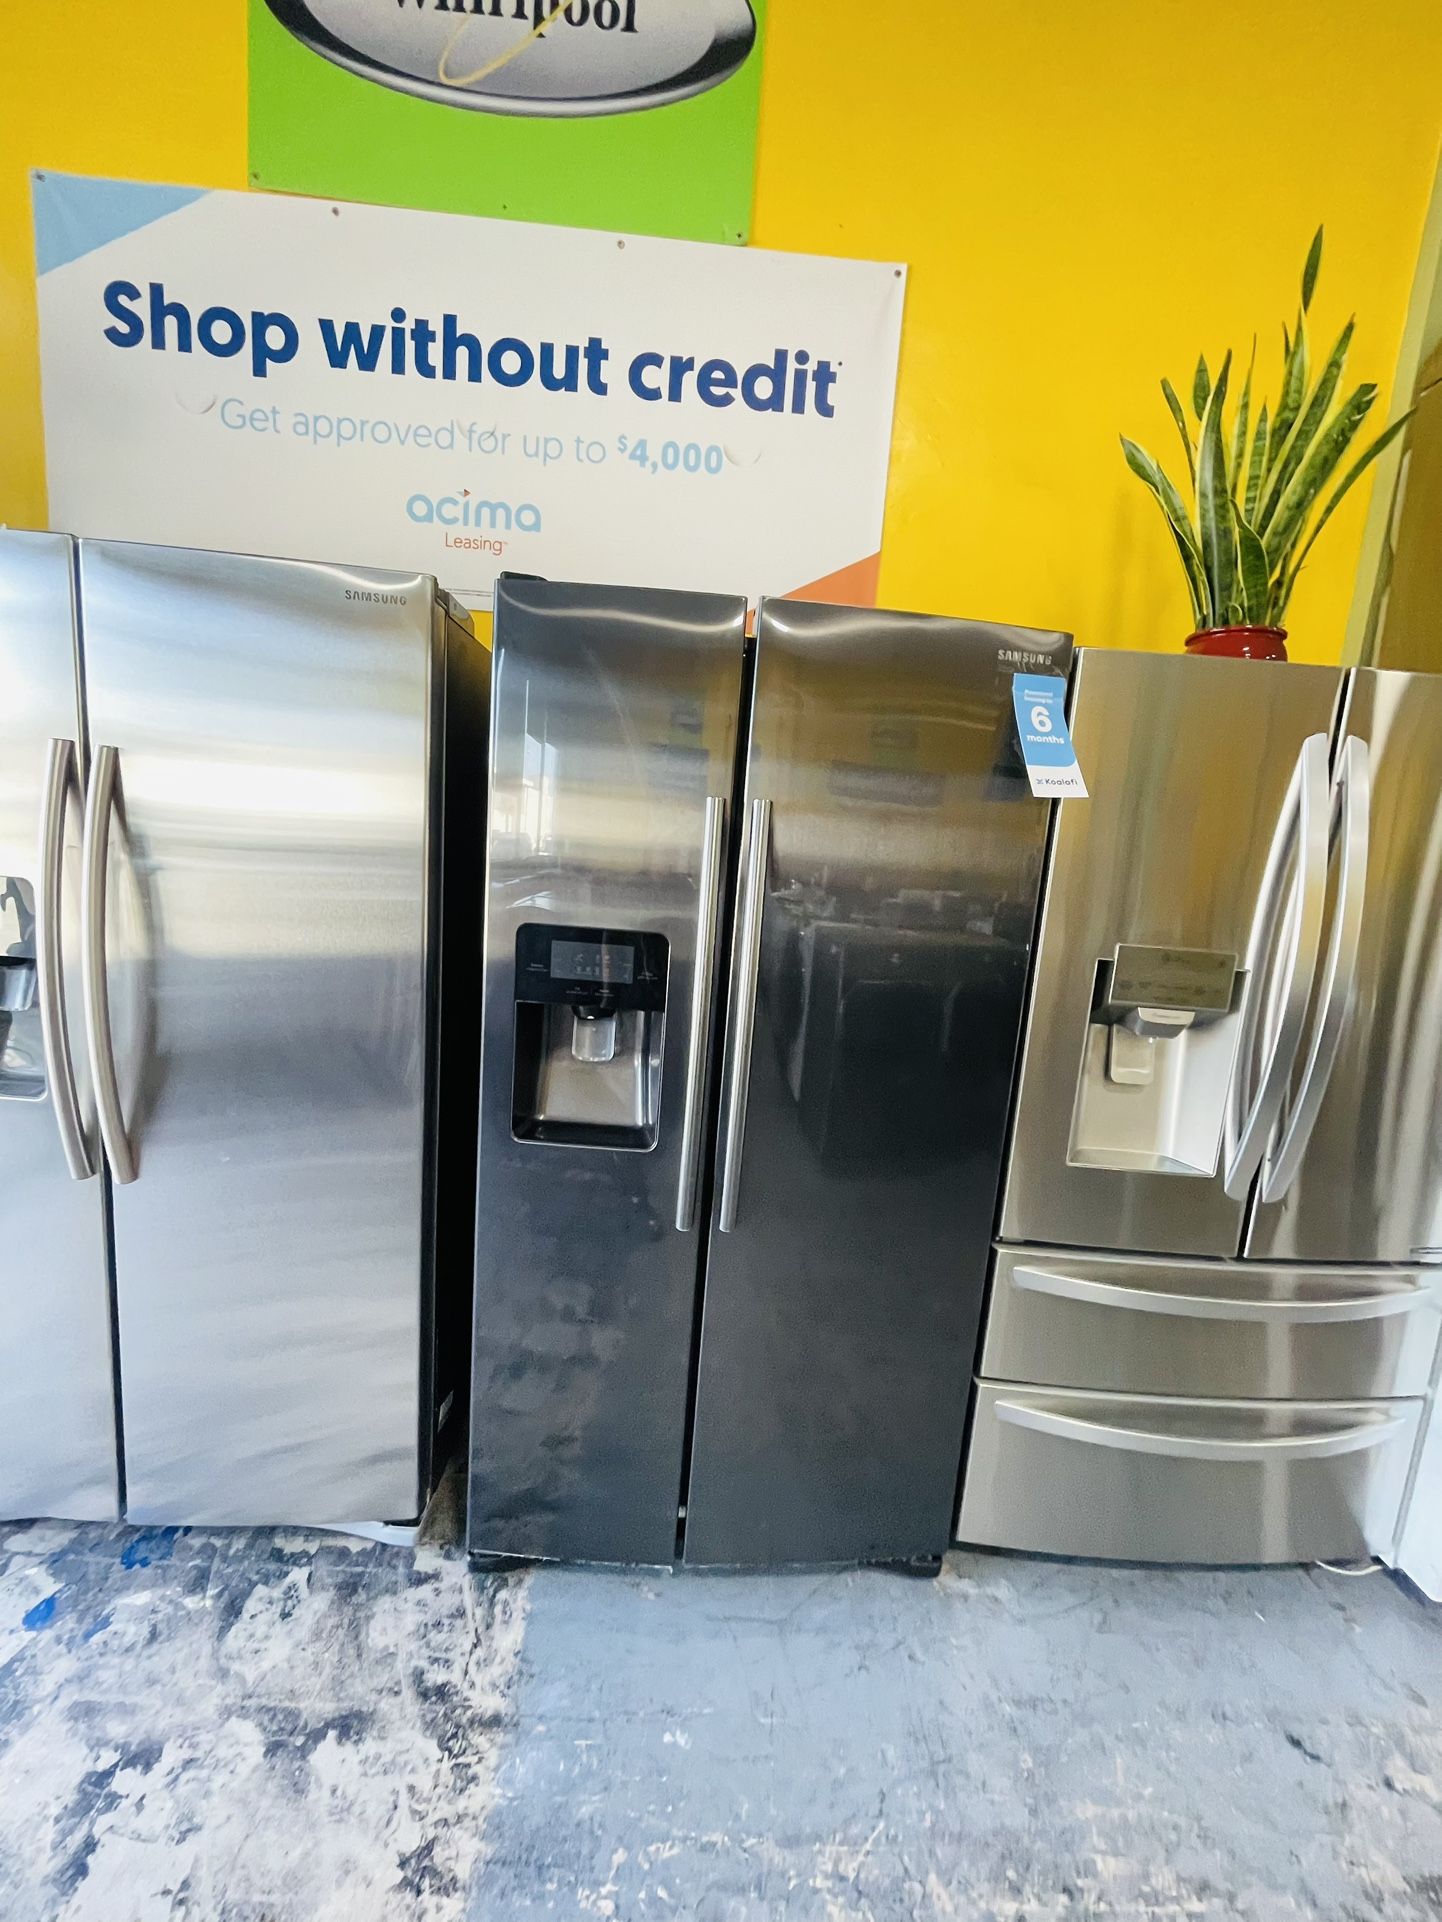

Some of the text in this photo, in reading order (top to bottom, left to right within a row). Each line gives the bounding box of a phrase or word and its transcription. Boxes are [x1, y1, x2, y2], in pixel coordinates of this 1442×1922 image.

[103, 280, 299, 378] Shop
[317, 307, 609, 396] without
[220, 397, 724, 475] Get approved for up to $4,000
[406, 493, 542, 533] acima
[445, 532, 503, 556] Leasing
[345, 589, 407, 605] SAMSUNG
[997, 649, 1053, 665] SAMSUNG
[1030, 705, 1053, 733] 6
[1026, 734, 1065, 744] months
[1045, 778, 1078, 786] Koalafi
